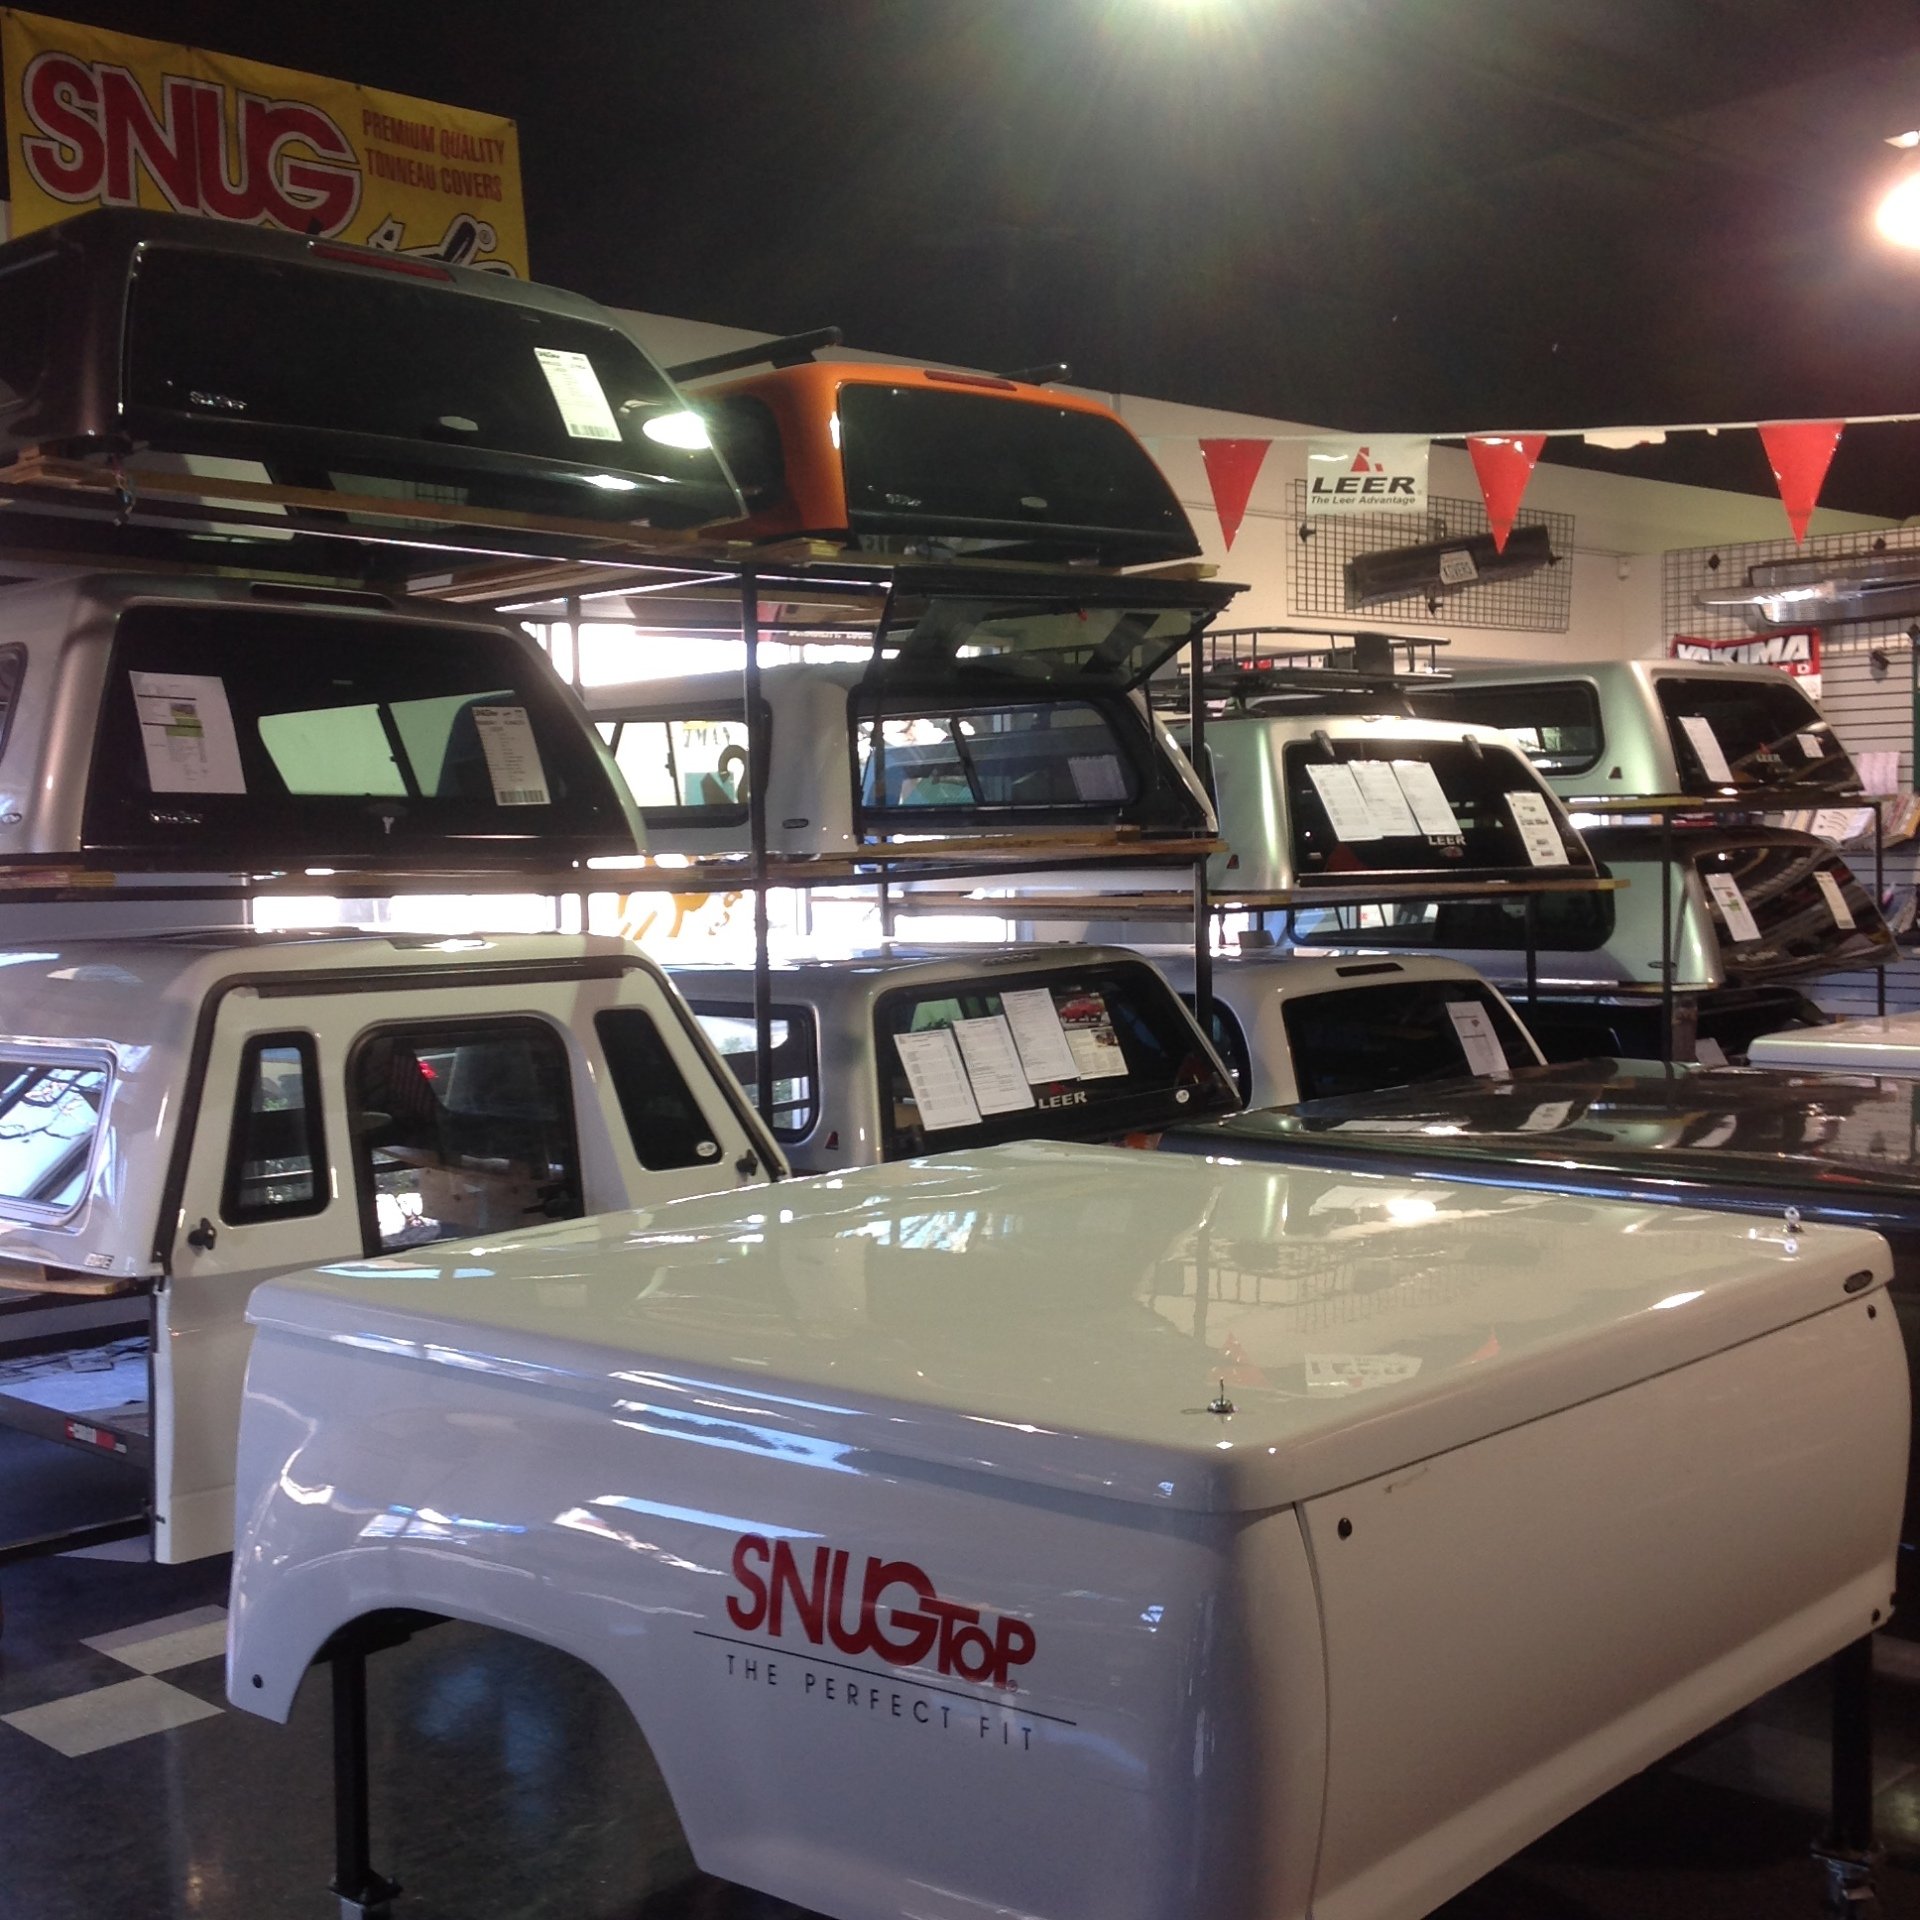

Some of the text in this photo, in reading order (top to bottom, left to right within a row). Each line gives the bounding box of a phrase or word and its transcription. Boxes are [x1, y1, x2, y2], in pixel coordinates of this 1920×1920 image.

[22, 50, 361, 238] SNUG
[362, 109, 505, 164] PREMIUM QUALITY
[365, 148, 503, 202] TONNEAU COVERS
[1311, 496, 1417, 506] The Leer Advantage
[1312, 477, 1416, 495] LEER
[1676, 634, 1810, 665] YAKIMA
[1428, 833, 1467, 846] LEER
[1038, 1090, 1088, 1110] LEER
[726, 1654, 1033, 1751] THE PERFECT FIT
